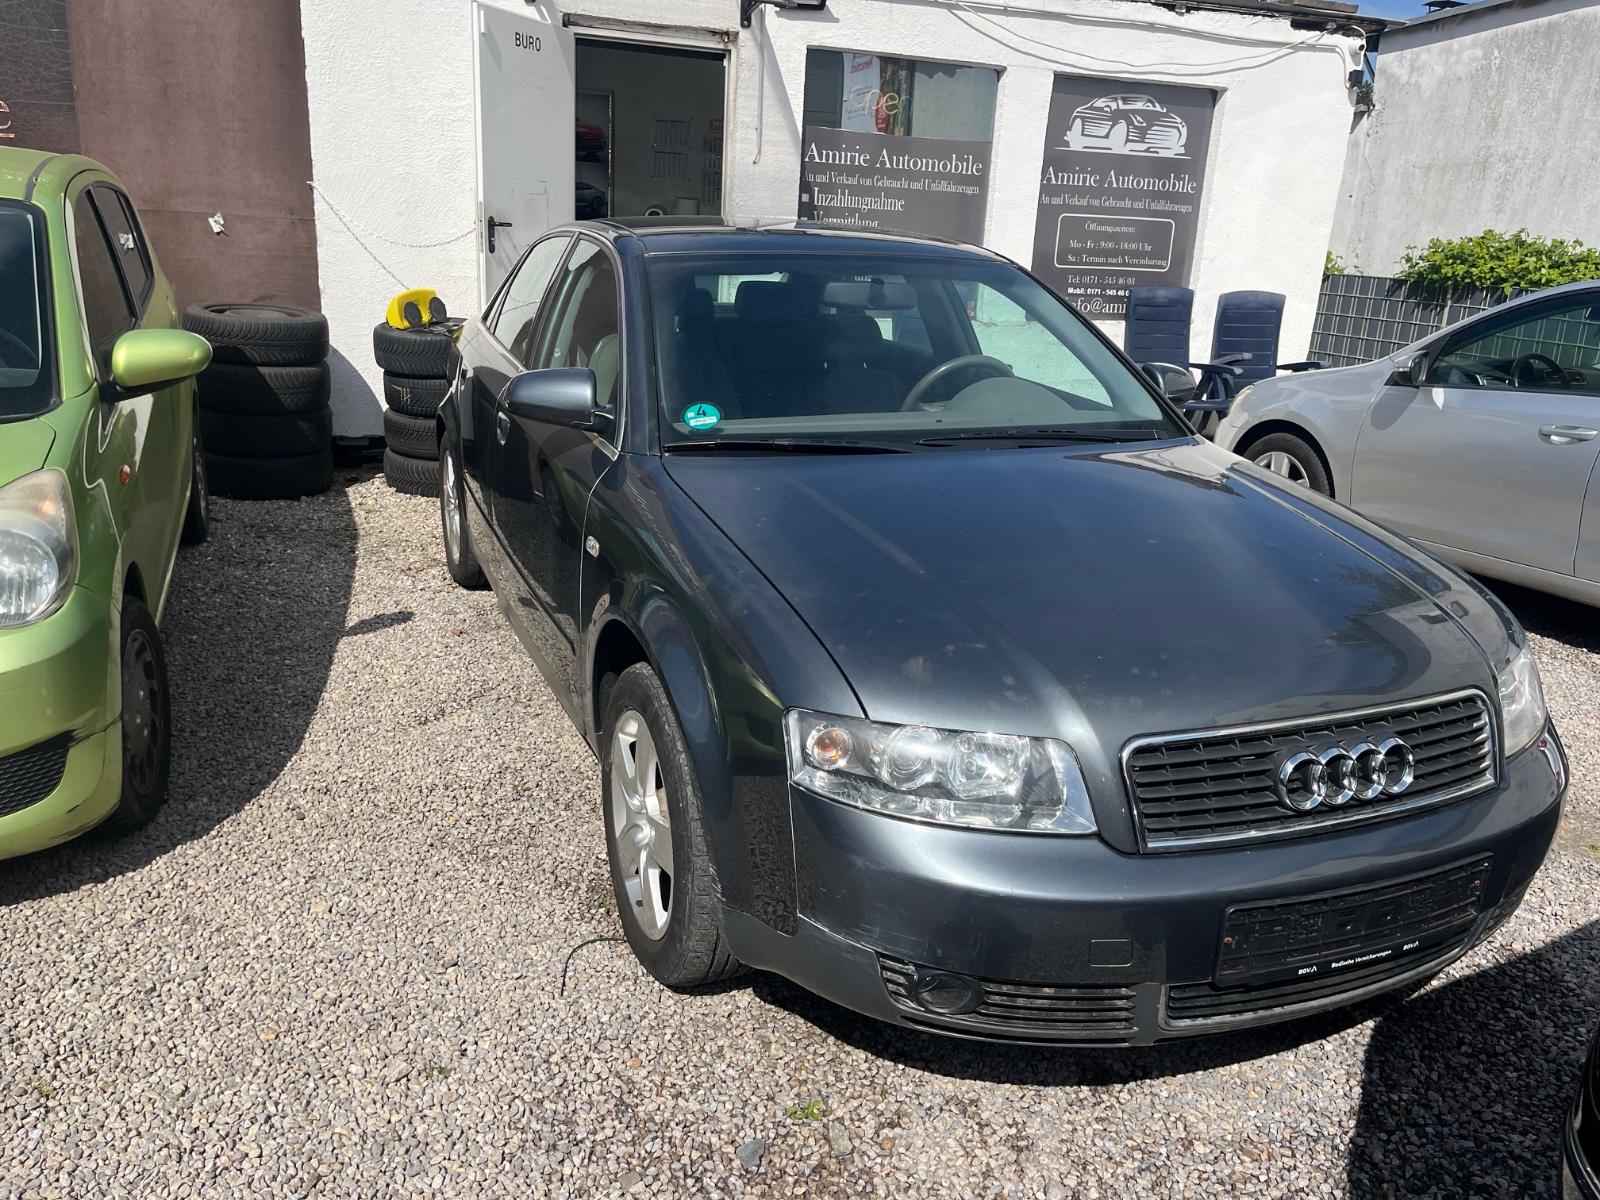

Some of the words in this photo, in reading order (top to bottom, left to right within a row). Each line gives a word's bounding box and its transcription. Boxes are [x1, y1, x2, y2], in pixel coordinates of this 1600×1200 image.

[804, 142, 871, 167] Amirie
[876, 148, 983, 175] Automobile
[815, 171, 830, 183] und
[831, 172, 858, 185] Verkauf
[859, 177, 873, 186] von
[874, 175, 909, 189] Gebraucht
[910, 179, 924, 190] und
[925, 179, 979, 195] Unfallfahrzeugen
[1041, 165, 1100, 187] Amirie
[1104, 169, 1197, 194] Automobile
[814, 187, 905, 213] Inzahlungnahme
[1040, 194, 1050, 204] An
[1051, 195, 1063, 205] und
[1065, 194, 1088, 206] Verkauf
[1089, 199, 1101, 207] von
[1101, 196, 1132, 209] Gebraucht
[1133, 198, 1145, 209] und
[1069, 240, 1081, 248] Mo
[1087, 240, 1094, 249] Fr
[1099, 241, 1115, 249] 9:00
[1120, 242, 1138, 250] 18:00
[1139, 242, 1152, 251] Uhr
[1067, 254, 1076, 262] Sa
[1081, 254, 1106, 263] Termin
[1107, 256, 1123, 264] nach
[1124, 255, 1168, 267] Vereinbarung
[1082, 275, 1098, 284] 0171
[1103, 276, 1117, 285] 545
[1067, 287, 1086, 295] Mobil:
[1087, 287, 1101, 295] 0171
